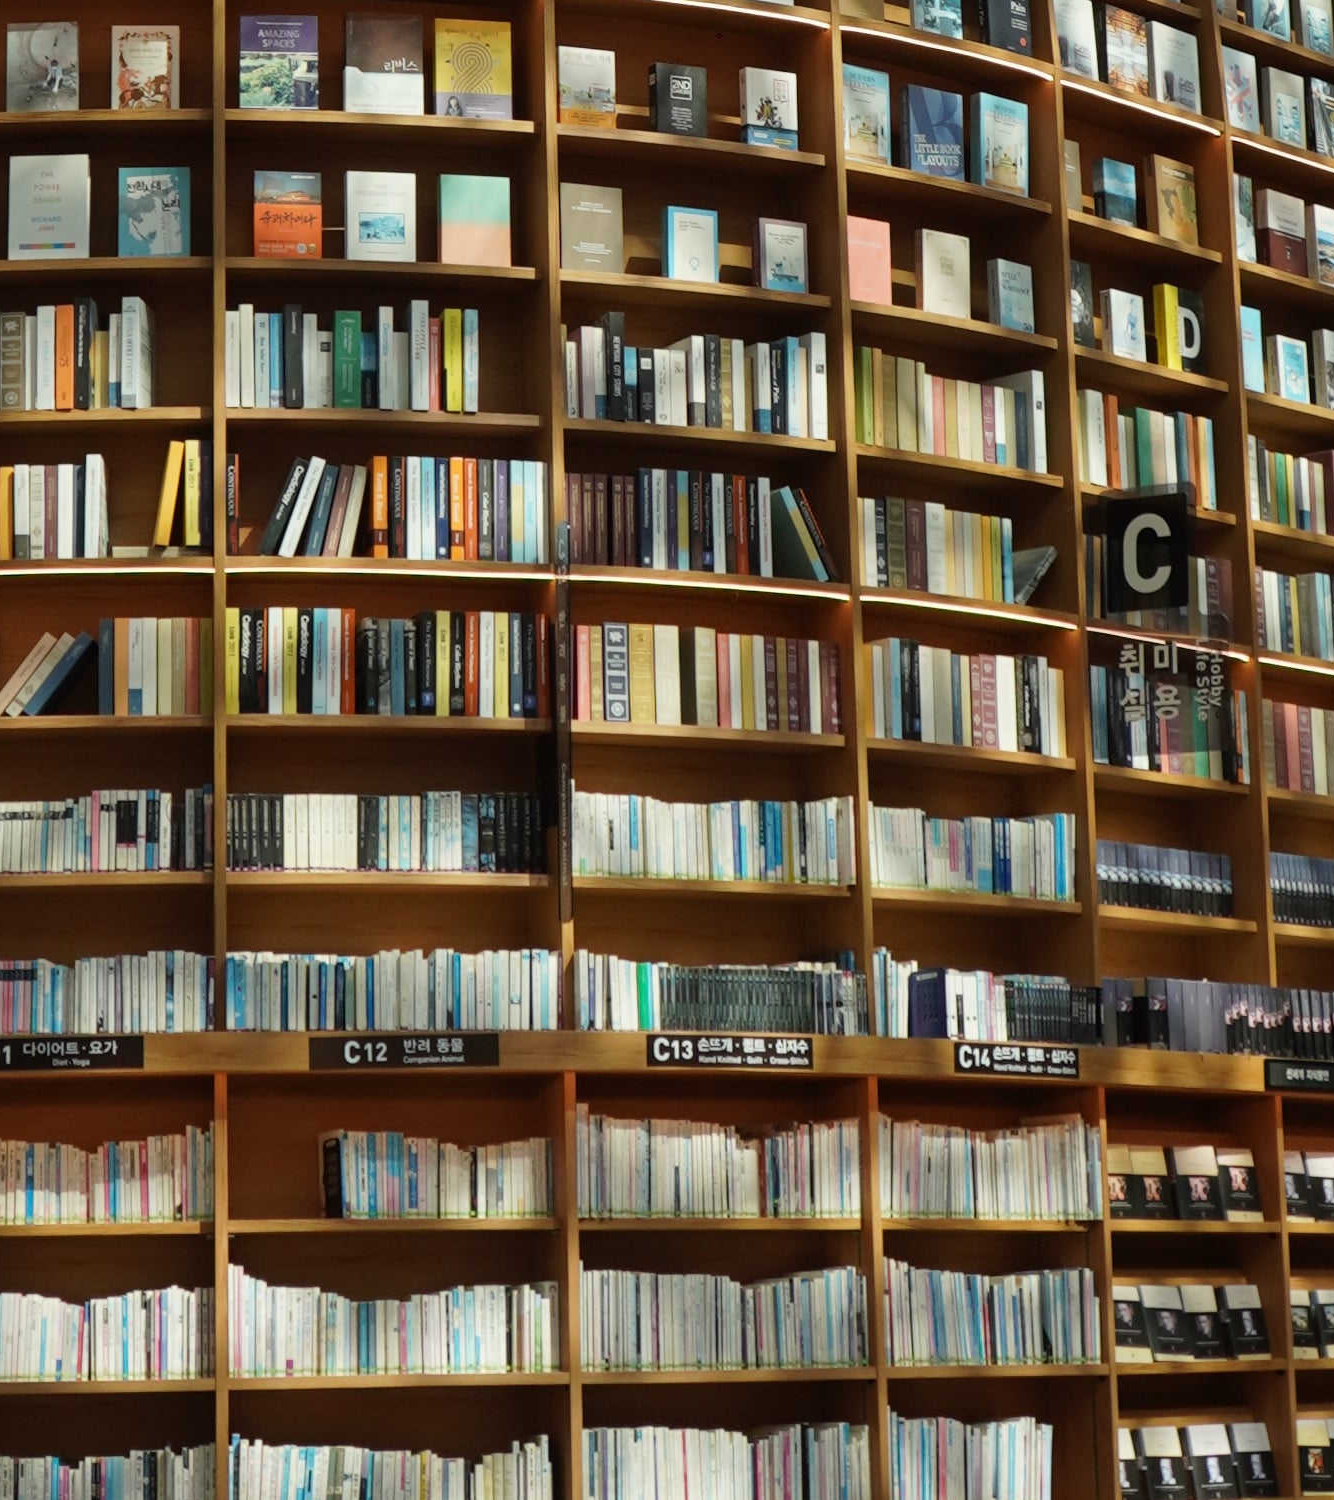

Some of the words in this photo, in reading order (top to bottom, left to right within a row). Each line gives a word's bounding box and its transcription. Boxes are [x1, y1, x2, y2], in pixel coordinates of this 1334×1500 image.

[1011, 1, 1027, 13] Pain
[257, 29, 300, 39] AMAZING
[261, 39, 297, 48] SPACES
[383, 58, 419, 73] 리버스
[671, 81, 691, 91] 2ND
[914, 134, 928, 143] THE
[914, 143, 939, 155] LITTLE
[940, 145, 962, 156] BOOK
[929, 152, 959, 168] LAYOUTS
[1178, 306, 1201, 358] D
[613, 364, 622, 377] CITY
[772, 382, 780, 404] Pain
[227, 465, 236, 516] CONTINUOUS
[281, 465, 305, 506] Cardiology
[1123, 513, 1172, 594] C
[241, 615, 252, 658] Cardiology
[286, 626, 294, 639] Link
[300, 614, 310, 658] Cardiology
[256, 619, 264, 671] CONTINUOUS
[1119, 640, 1178, 677] 취미
[1210, 651, 1224, 708] Hobby
[1119, 685, 1182, 723] 실용
[1193, 676, 1210, 722] Style
[344, 1040, 387, 1065] C12
[403, 1039, 431, 1054] 반려
[436, 1038, 464, 1053] 동물
[653, 1037, 694, 1062] C13
[697, 1037, 733, 1053] 손뜨개
[741, 1038, 766, 1053] 퀼트
[775, 1039, 809, 1054] 십자수
[993, 1046, 1020, 1062] 손뜨개
[1051, 1050, 1075, 1064] 십자수
[403, 1055, 440, 1065] Companion
[442, 1055, 465, 1064] Animal
[699, 1056, 716, 1064] Hand
[959, 1045, 991, 1069] C14
